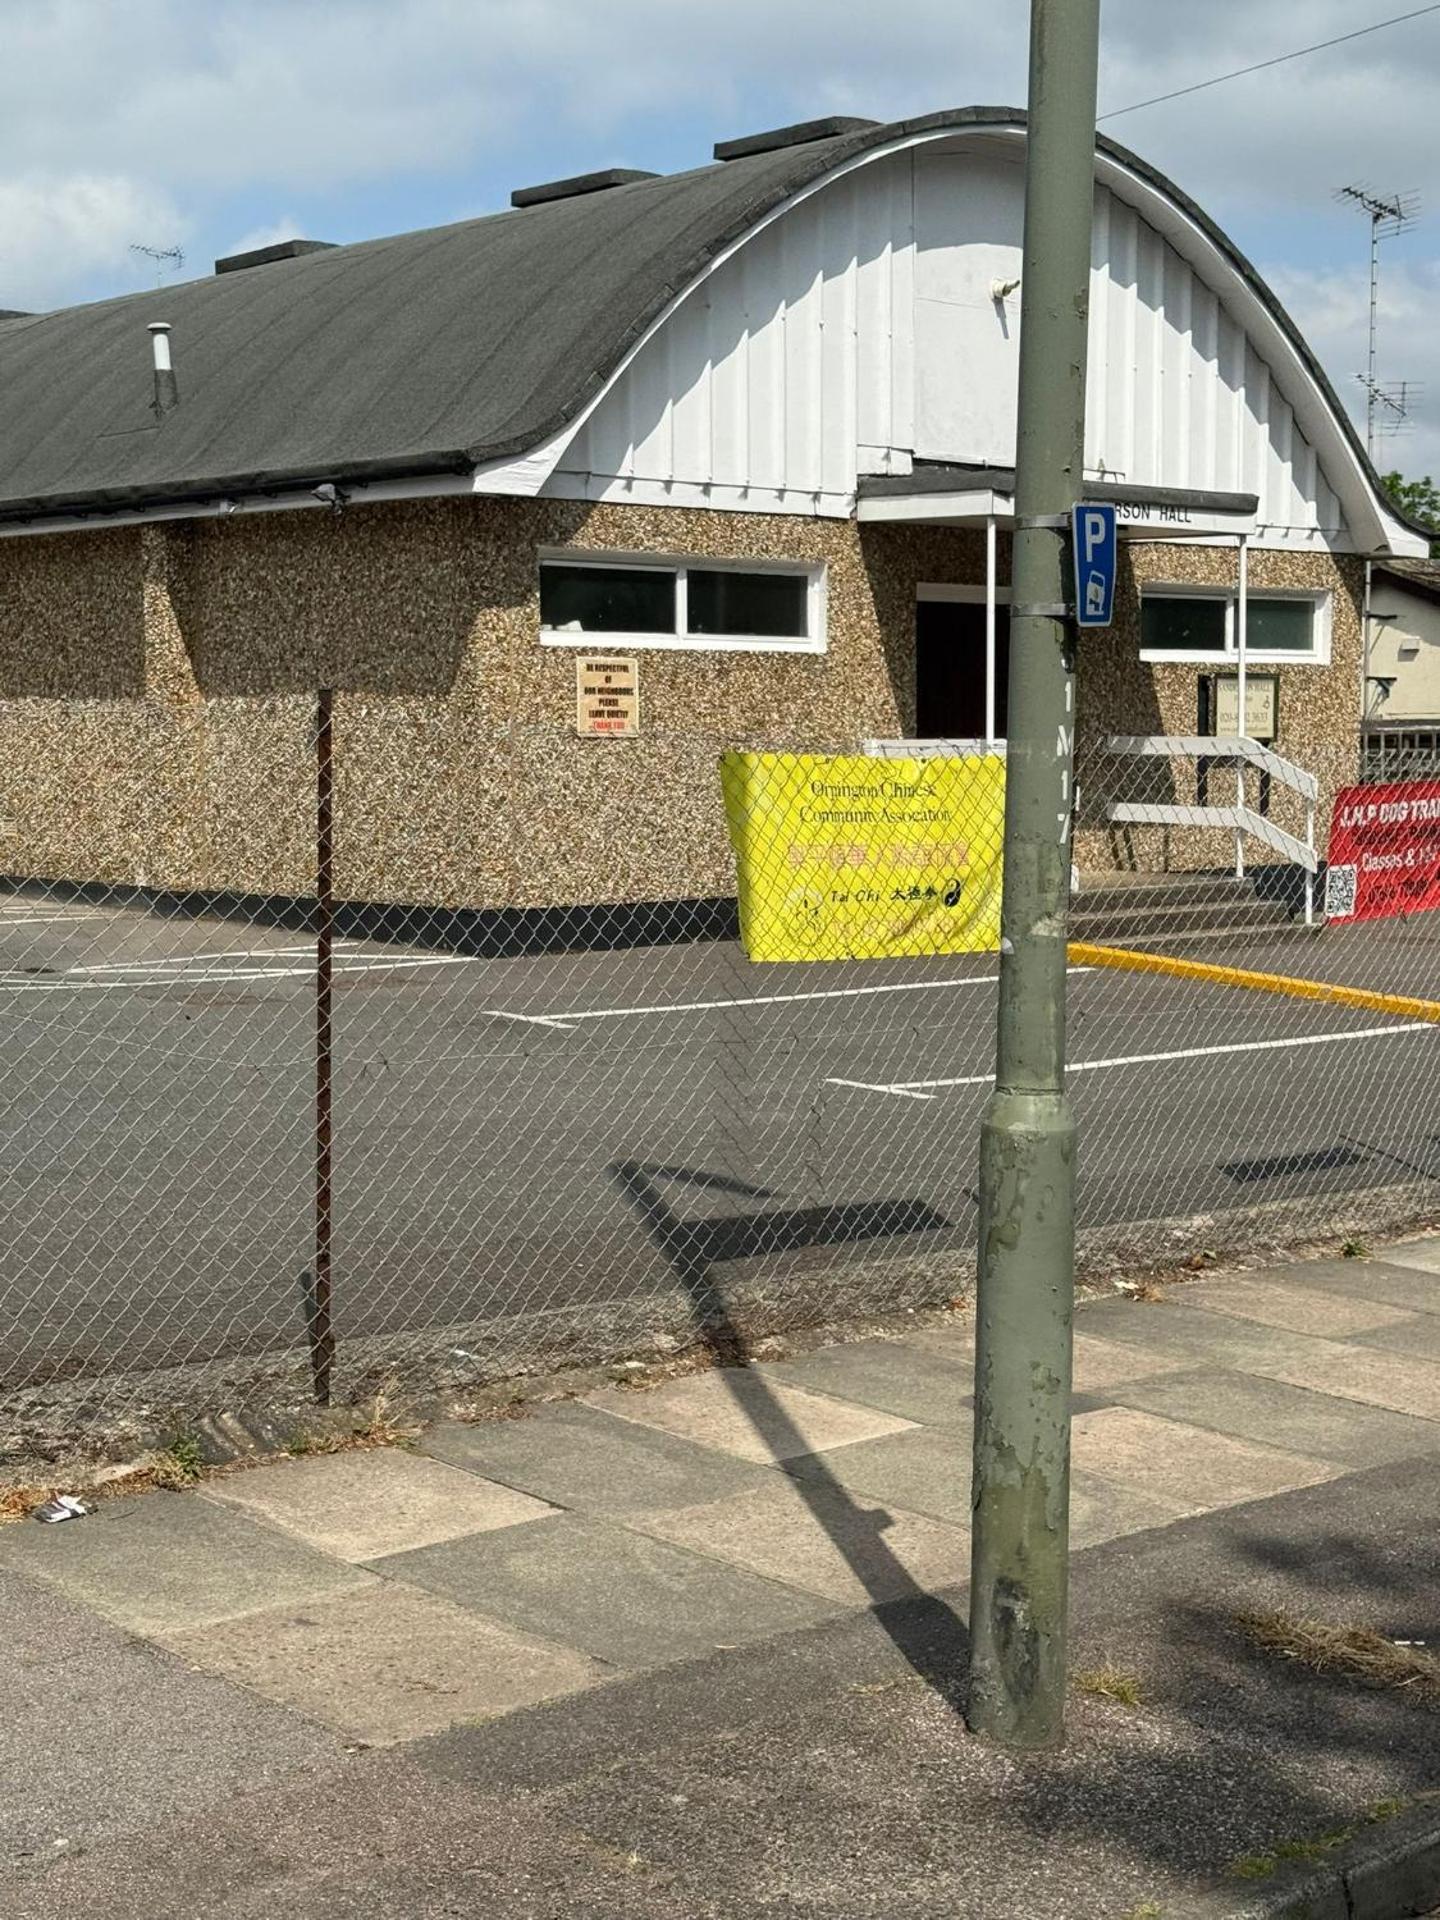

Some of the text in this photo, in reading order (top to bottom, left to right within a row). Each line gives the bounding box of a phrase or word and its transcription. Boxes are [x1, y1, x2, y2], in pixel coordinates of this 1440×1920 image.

[1160, 504, 1191, 523] HALL
[1085, 513, 1106, 563] P
[595, 664, 629, 673] RESPECTFUL
[599, 698, 619, 707] PLEASE
[811, 780, 937, 800] Orpington Chinese
[1380, 801, 1408, 823] DOG
[831, 890, 848, 902] Tai
[854, 889, 880, 902] Chi
